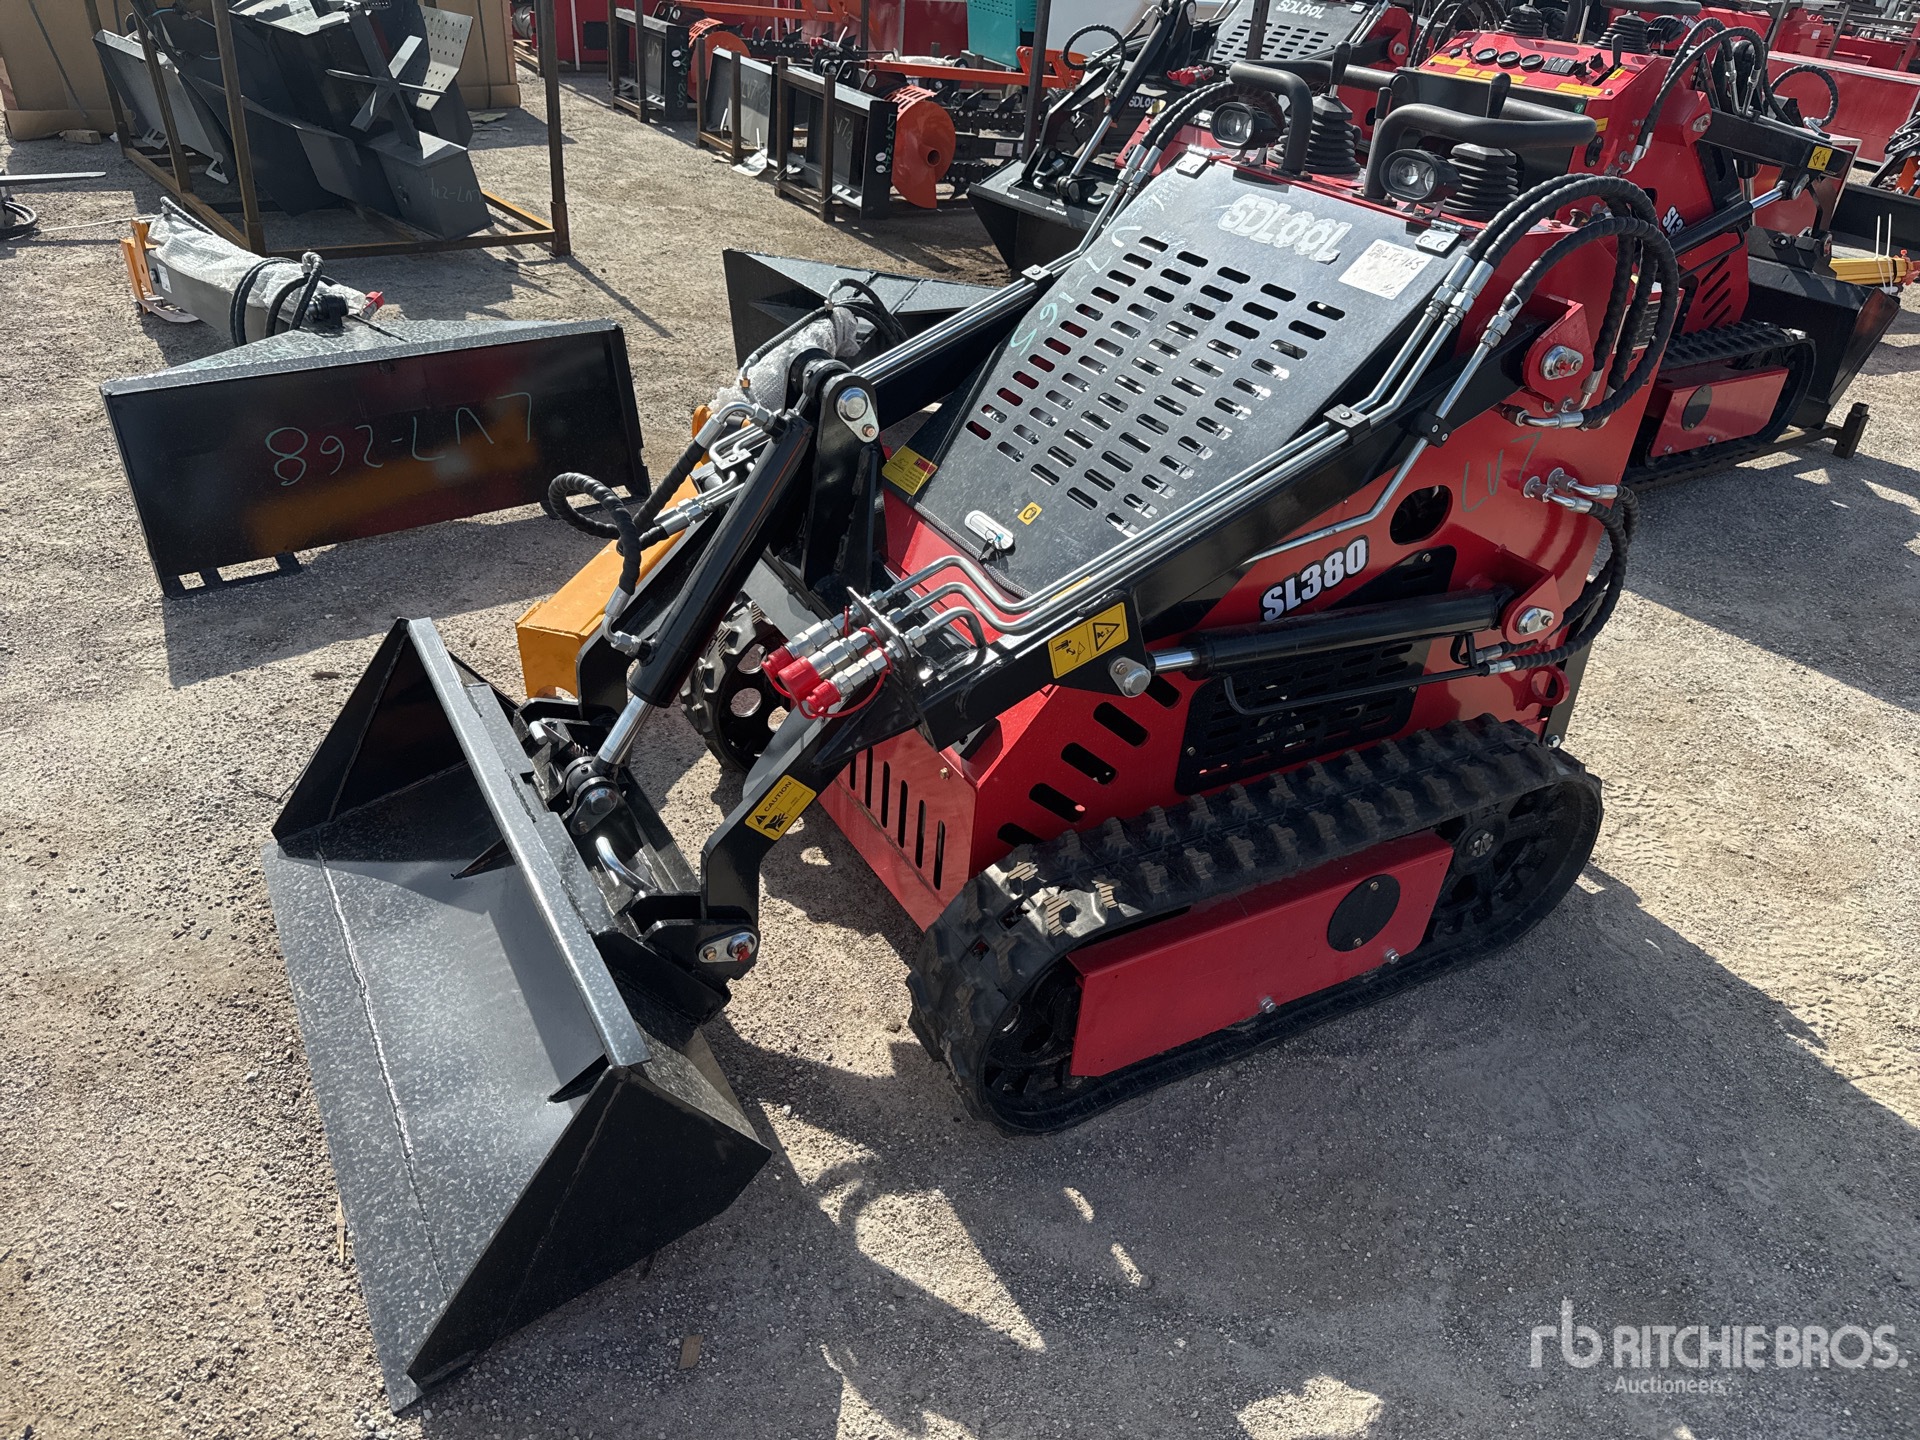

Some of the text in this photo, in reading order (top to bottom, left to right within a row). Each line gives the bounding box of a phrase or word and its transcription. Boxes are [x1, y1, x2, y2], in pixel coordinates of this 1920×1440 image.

[1218, 194, 1352, 262] SDLOOL
[1262, 538, 1367, 623] SL380
[764, 781, 792, 812] CAUTION
